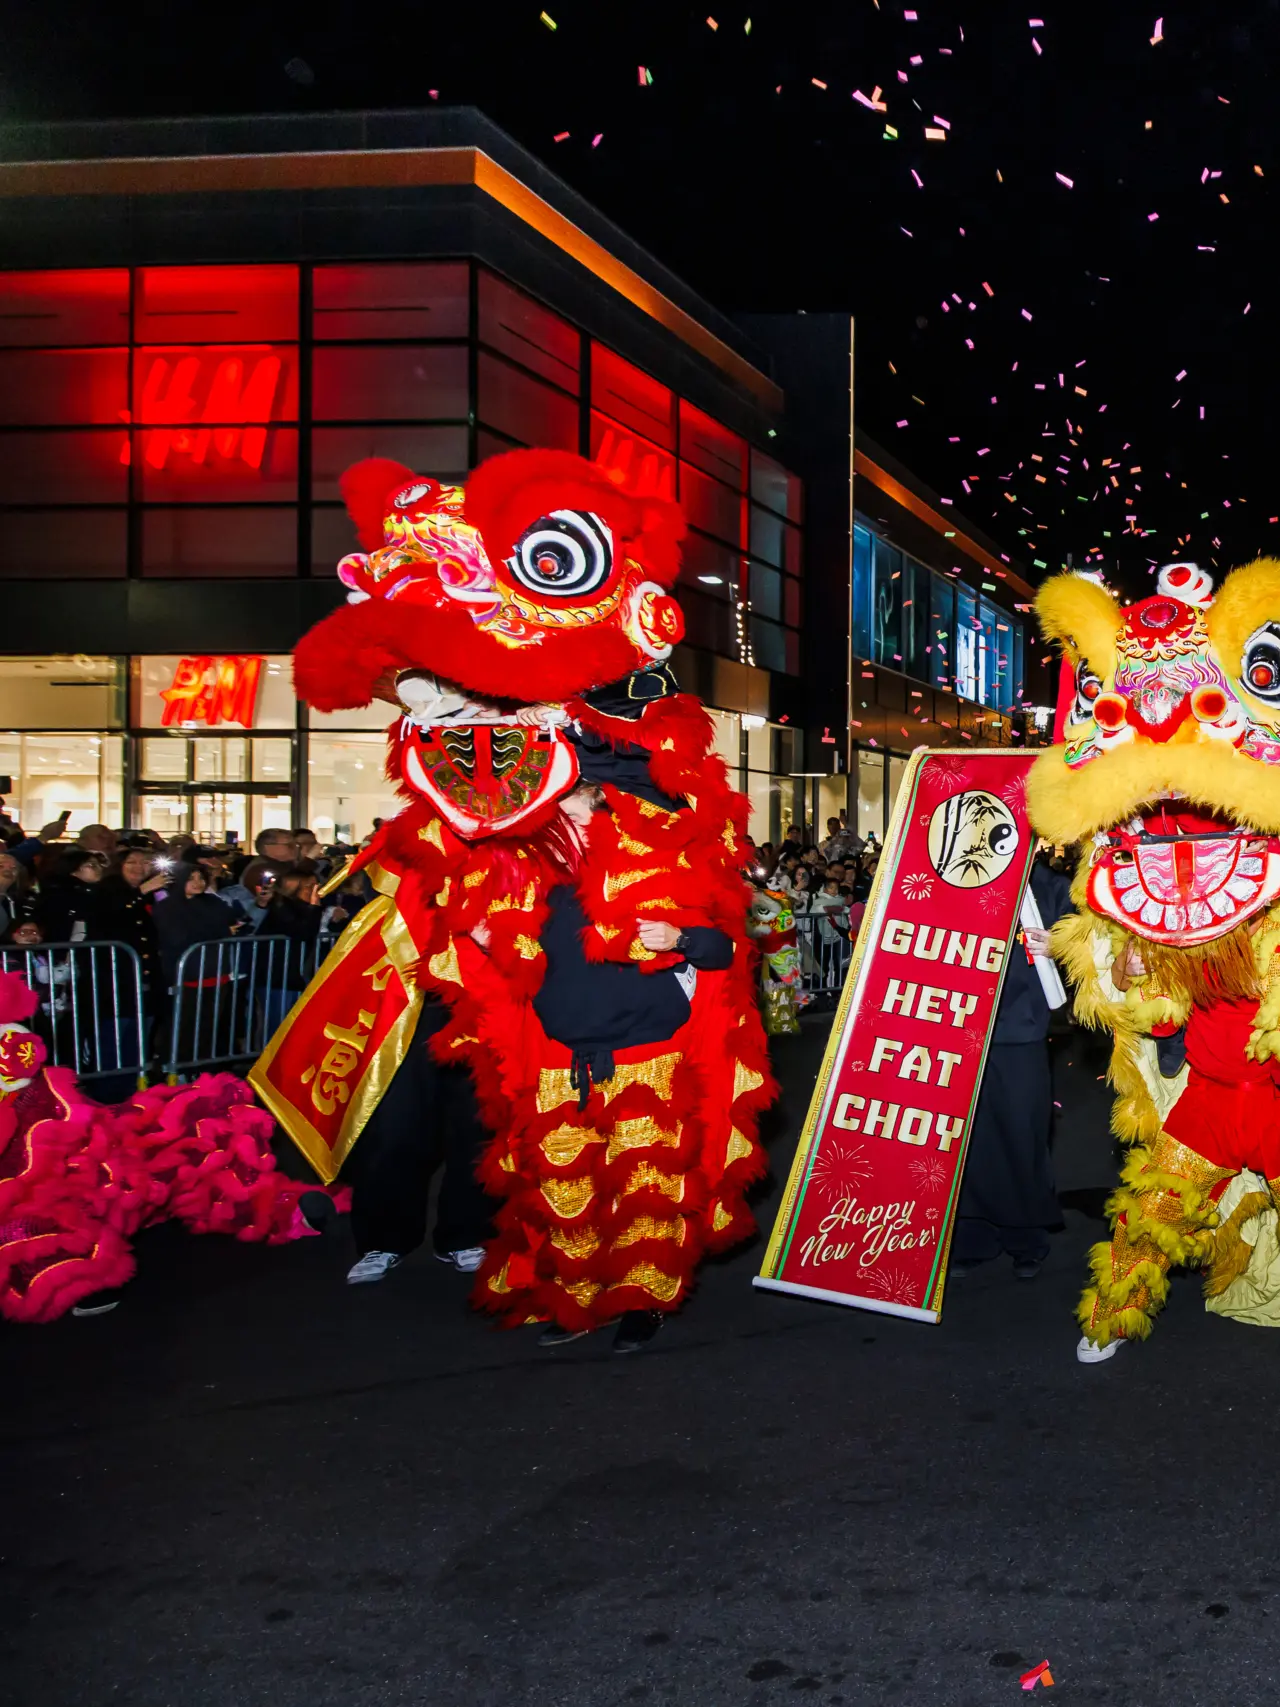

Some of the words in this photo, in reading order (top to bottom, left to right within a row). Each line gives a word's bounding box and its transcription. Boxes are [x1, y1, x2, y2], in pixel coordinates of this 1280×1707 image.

[118, 356, 282, 470] H&M
[159, 655, 264, 729] H&M
[879, 918, 1007, 974] GUNG
[879, 977, 980, 1029] HEY
[867, 1036, 963, 1088] FAT
[831, 1092, 967, 1153] CHOY
[818, 1197, 916, 1234] Happy
[799, 1232, 855, 1268] New
[859, 1223, 937, 1268] Year!
